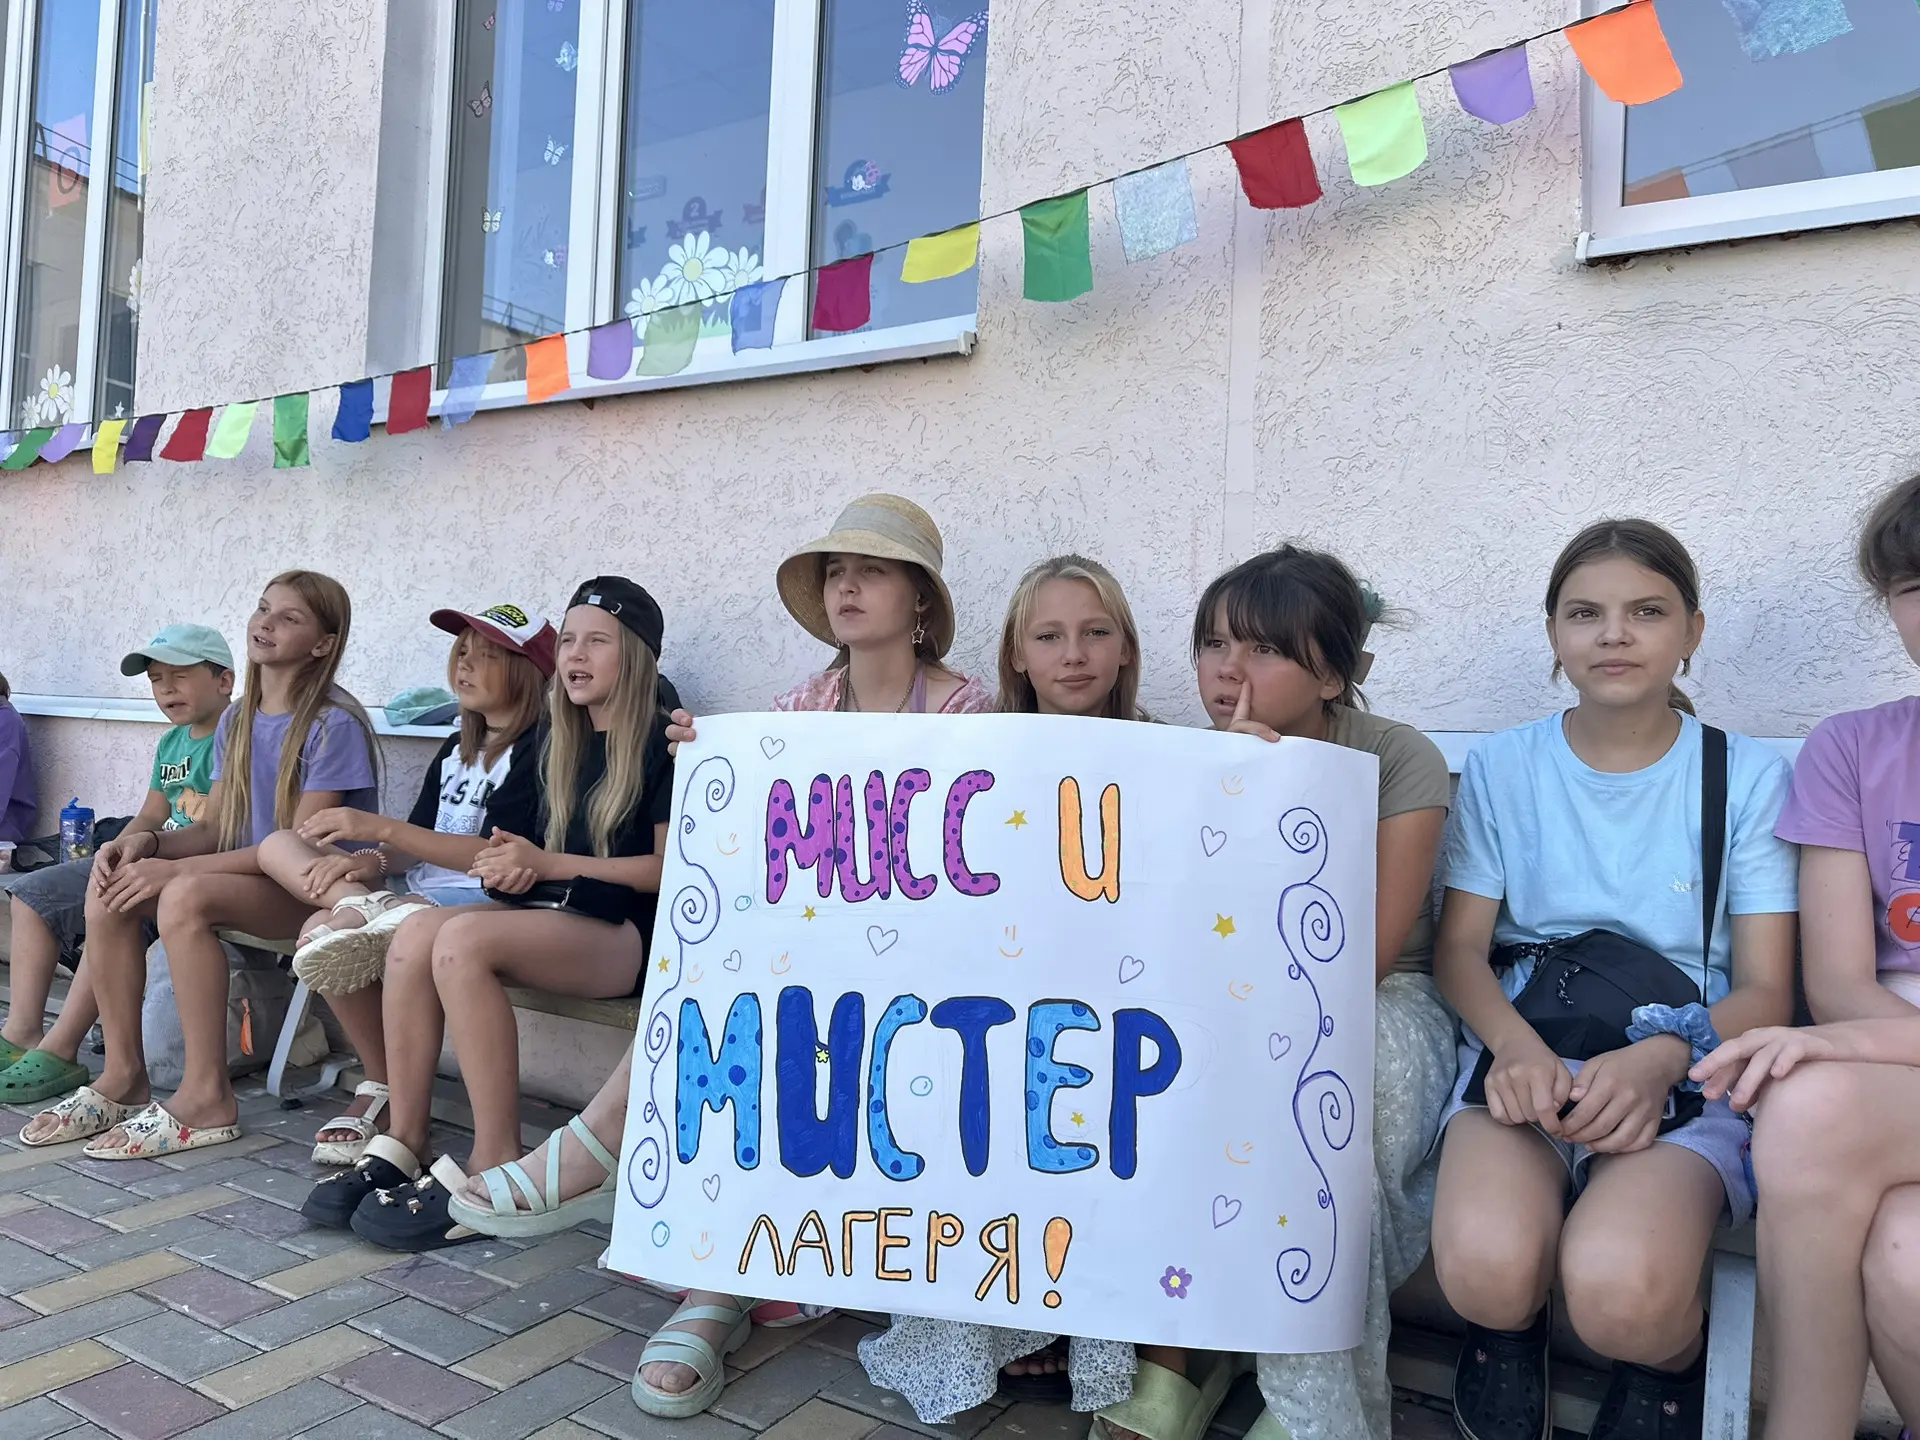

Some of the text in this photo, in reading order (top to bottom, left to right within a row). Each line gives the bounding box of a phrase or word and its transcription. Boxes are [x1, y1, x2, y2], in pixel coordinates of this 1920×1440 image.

[765, 768, 1120, 905] МИСС И
[675, 986, 1183, 1181] МИСТЕР
